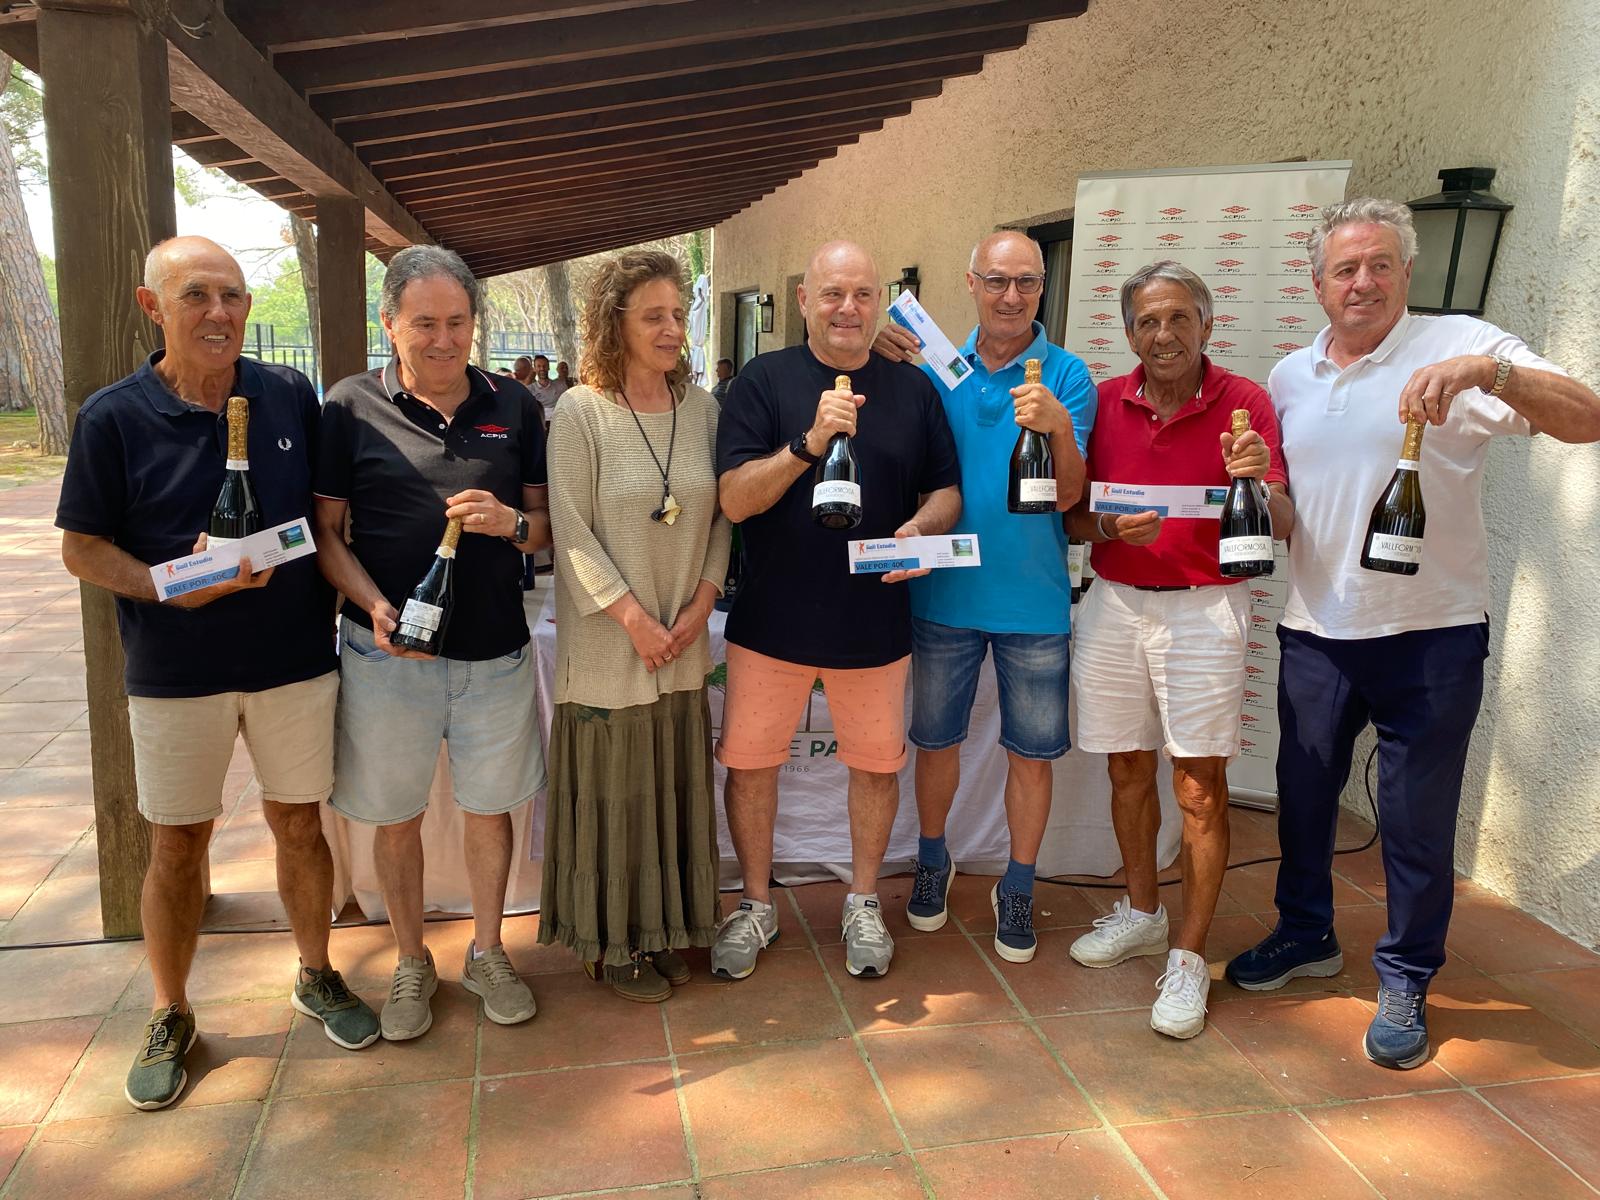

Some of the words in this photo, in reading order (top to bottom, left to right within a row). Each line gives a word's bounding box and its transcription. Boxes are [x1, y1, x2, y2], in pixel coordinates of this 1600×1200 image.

[1096, 503, 1113, 512] VALE
[855, 562, 873, 571] VALE
[166, 582, 188, 596] VALE
[810, 740, 839, 758] PA
[784, 765, 810, 773] 1966
